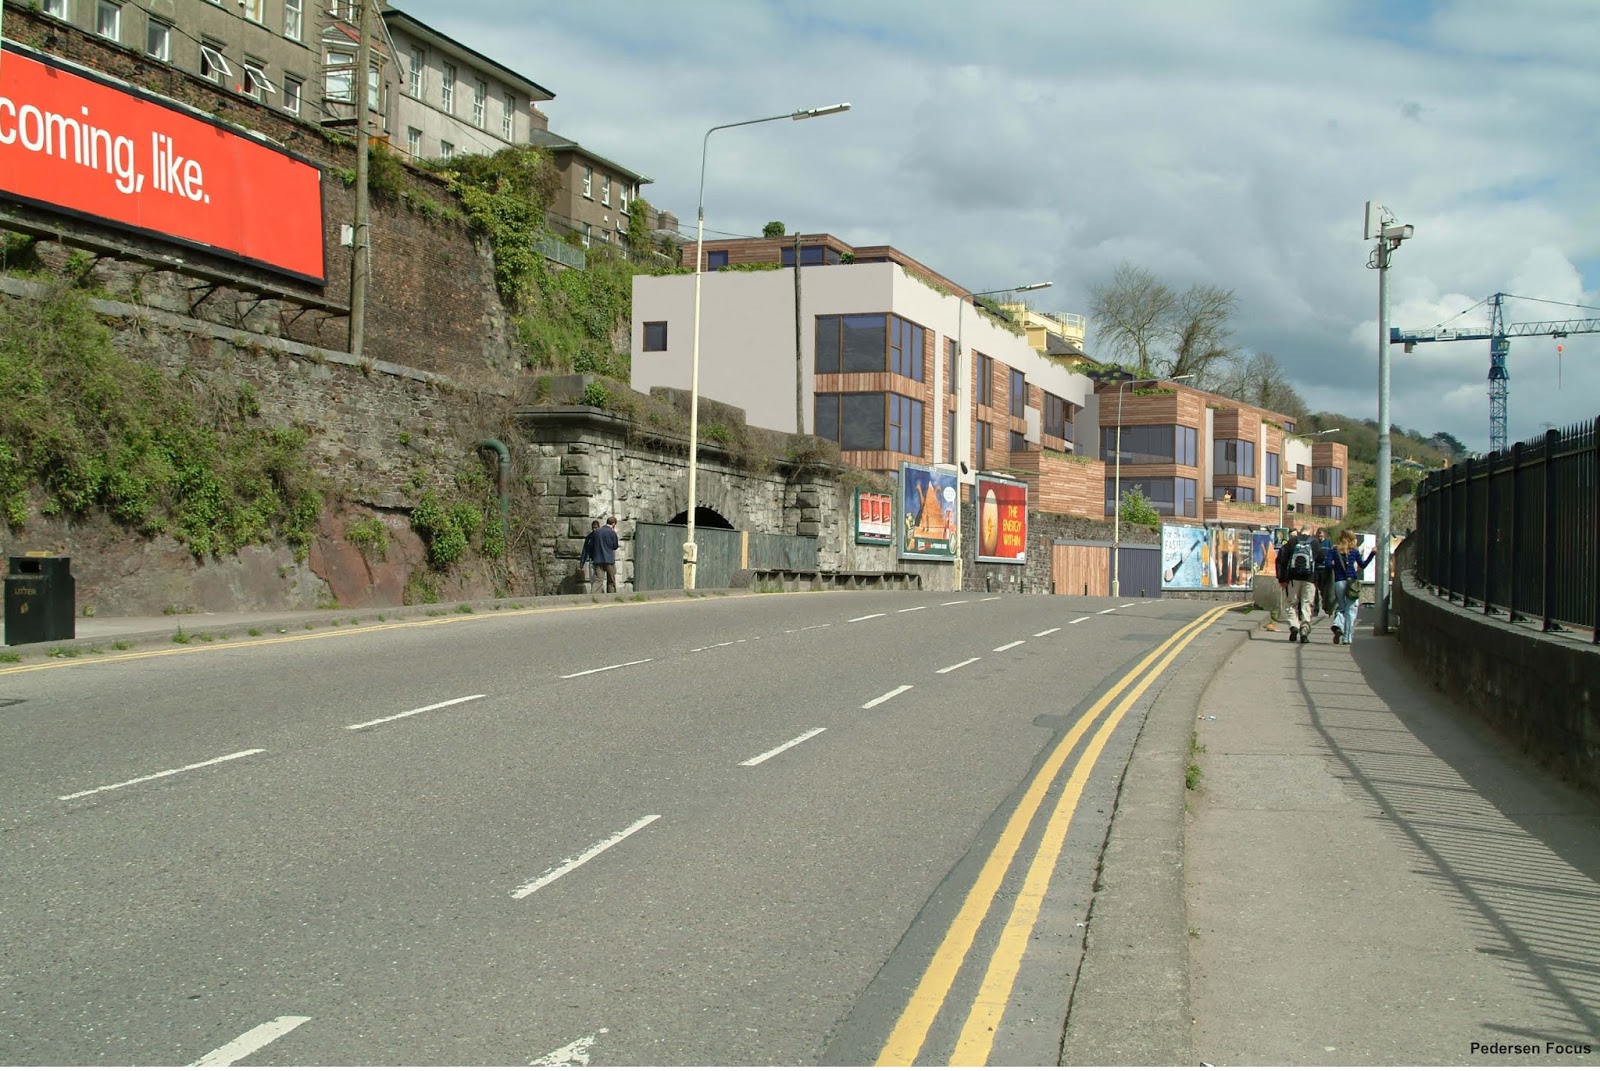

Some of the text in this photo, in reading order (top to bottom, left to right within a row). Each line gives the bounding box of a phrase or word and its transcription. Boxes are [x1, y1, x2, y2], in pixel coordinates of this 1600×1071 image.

[0, 96, 210, 203] coming, like.
[1008, 505, 1018, 518] THE
[1003, 519, 1022, 532] ENERGY
[1003, 534, 1021, 547] WITHIN
